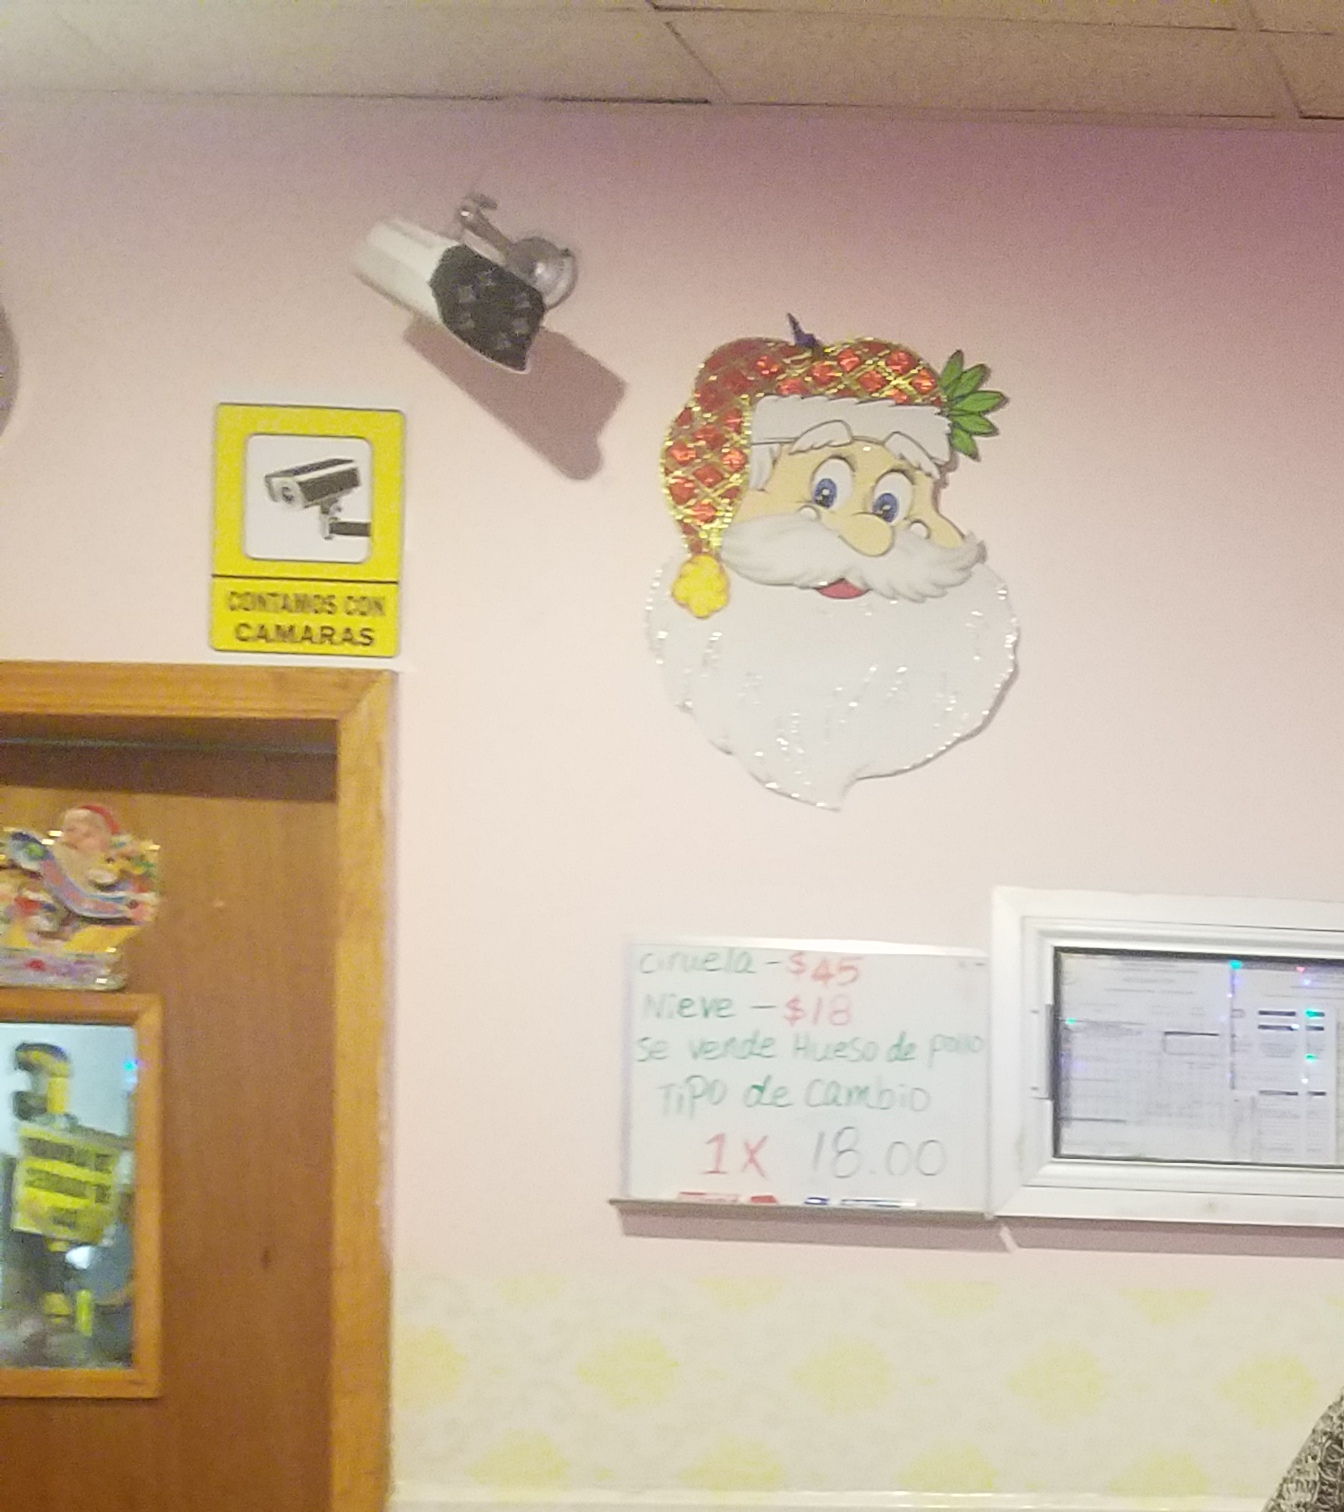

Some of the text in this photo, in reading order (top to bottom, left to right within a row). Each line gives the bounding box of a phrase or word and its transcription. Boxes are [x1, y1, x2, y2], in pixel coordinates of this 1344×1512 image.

[228, 590, 387, 617] CONTAMOS CON
[234, 622, 375, 647] CAMARAS
[788, 950, 861, 988] $45
[783, 995, 853, 1027] $18
[688, 1029, 777, 1060] vende
[886, 1030, 917, 1063] de
[742, 1074, 793, 1108] de
[812, 1125, 948, 1179] 18.00
